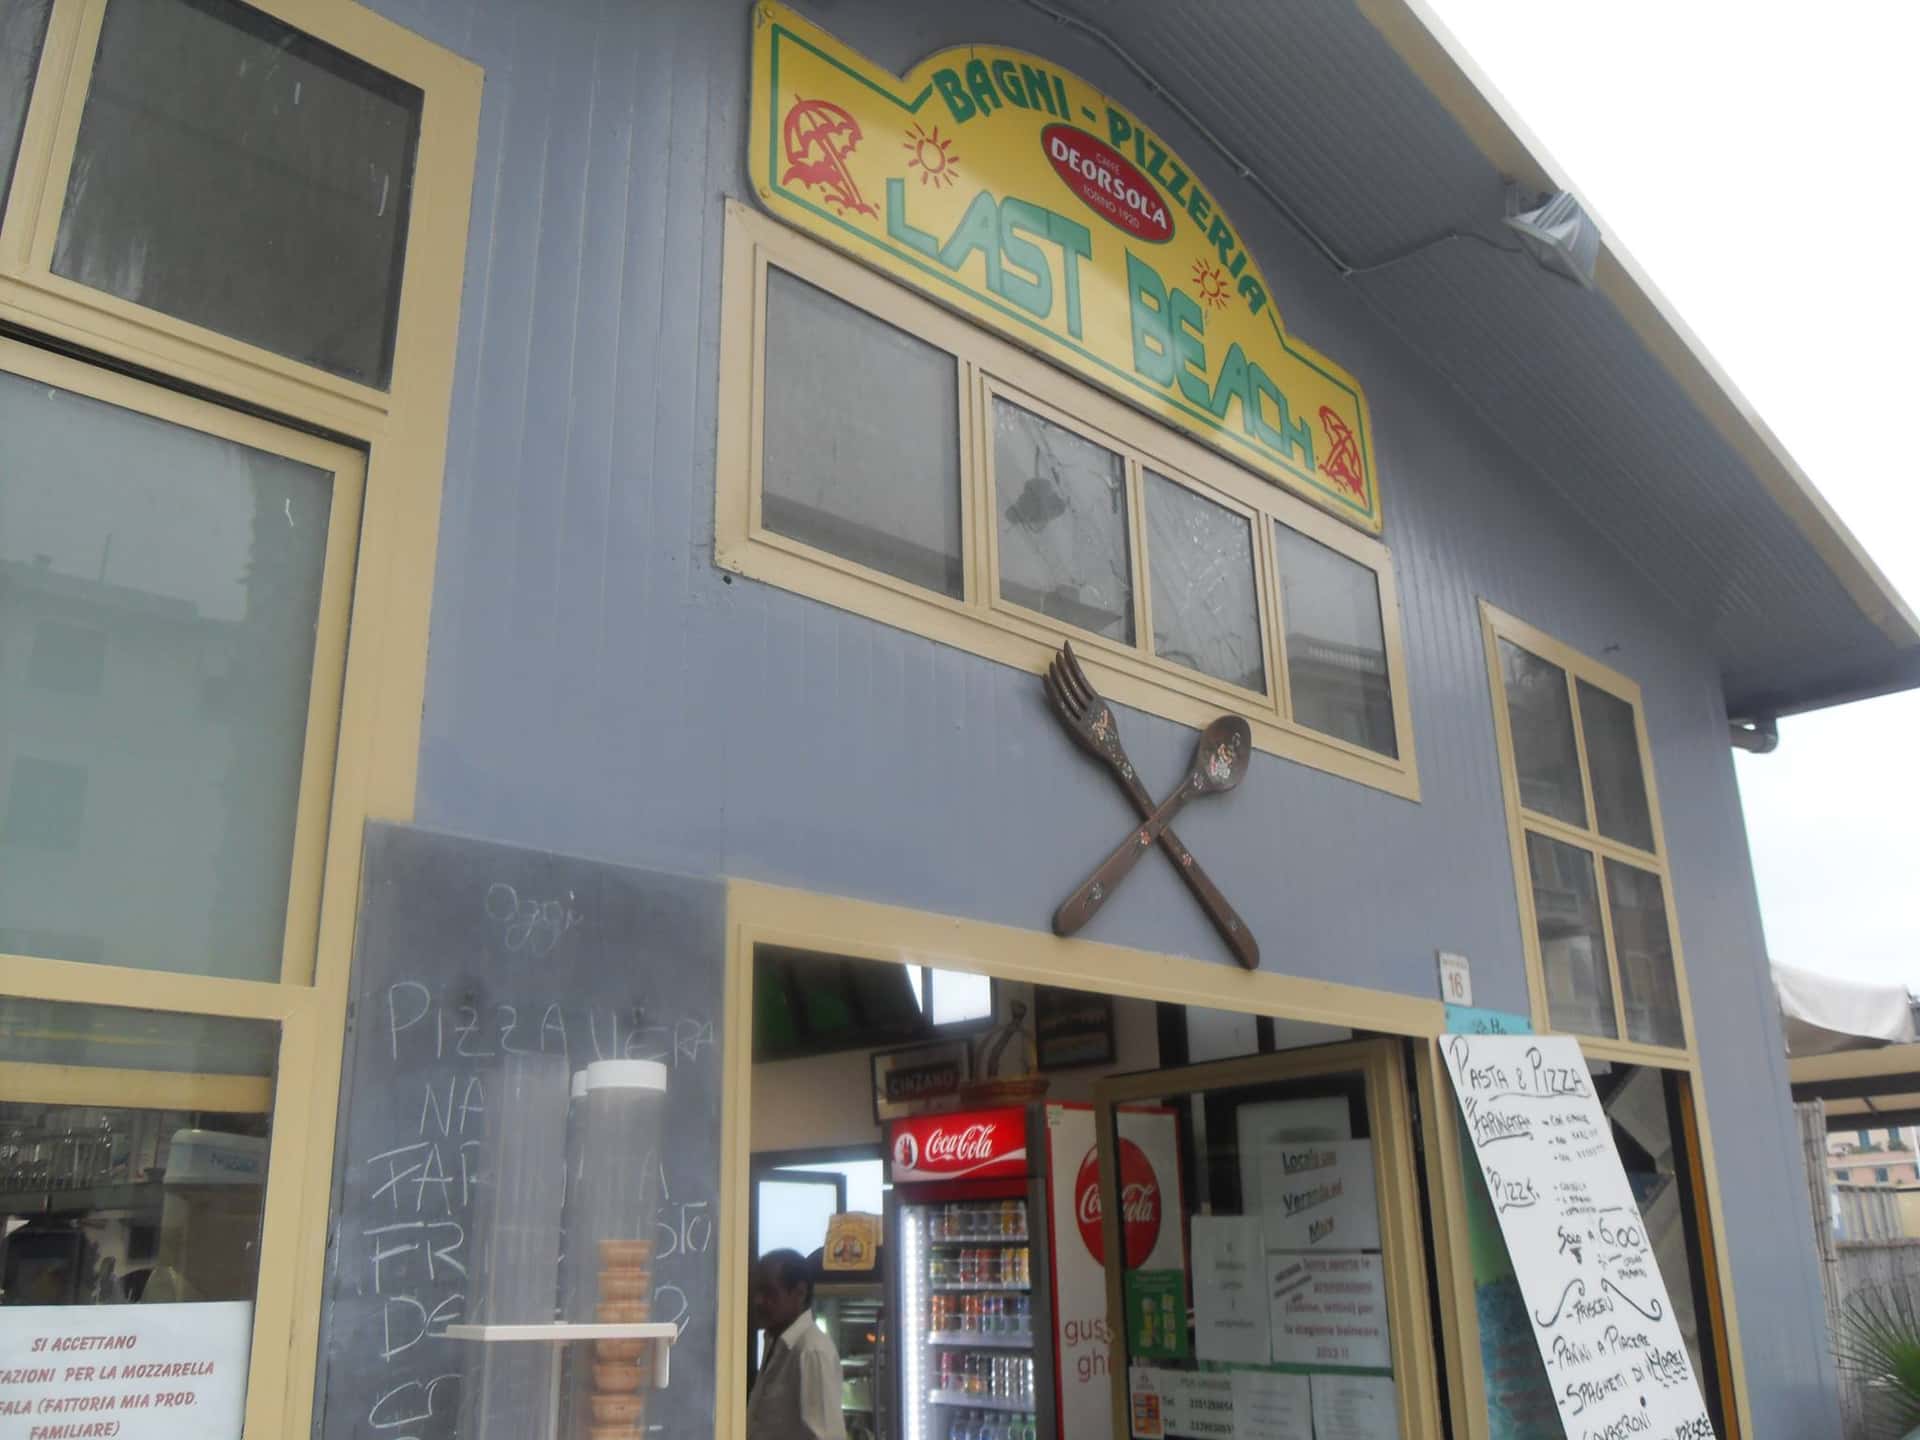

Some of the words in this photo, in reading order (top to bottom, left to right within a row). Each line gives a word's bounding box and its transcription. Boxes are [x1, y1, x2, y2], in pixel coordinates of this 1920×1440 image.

[931, 59, 1071, 124] BAGNI
[1105, 105, 1267, 315] PIZZERIA
[1051, 137, 1167, 230] DEORSOLA
[886, 177, 1093, 342] LAST
[1125, 247, 1316, 473] BEACH
[1449, 972, 1464, 998] 16
[388, 981, 570, 1061] PIZZA
[1449, 1034, 1510, 1090] PASTA
[1525, 1046, 1585, 1093] PIZZA
[32, 1337, 48, 1352] SI
[52, 1335, 137, 1352] ACCETTANO
[1553, 1336, 1592, 1370] PANINI
[64, 1366, 94, 1382] PER
[99, 1365, 117, 1380] LA
[121, 1361, 215, 1378] MOZZARELLA
[37, 1397, 115, 1415] (FATTORIA
[119, 1395, 149, 1409] MIA
[153, 1391, 198, 1407] PROD.
[29, 1420, 121, 1440] FAMILIARE)
